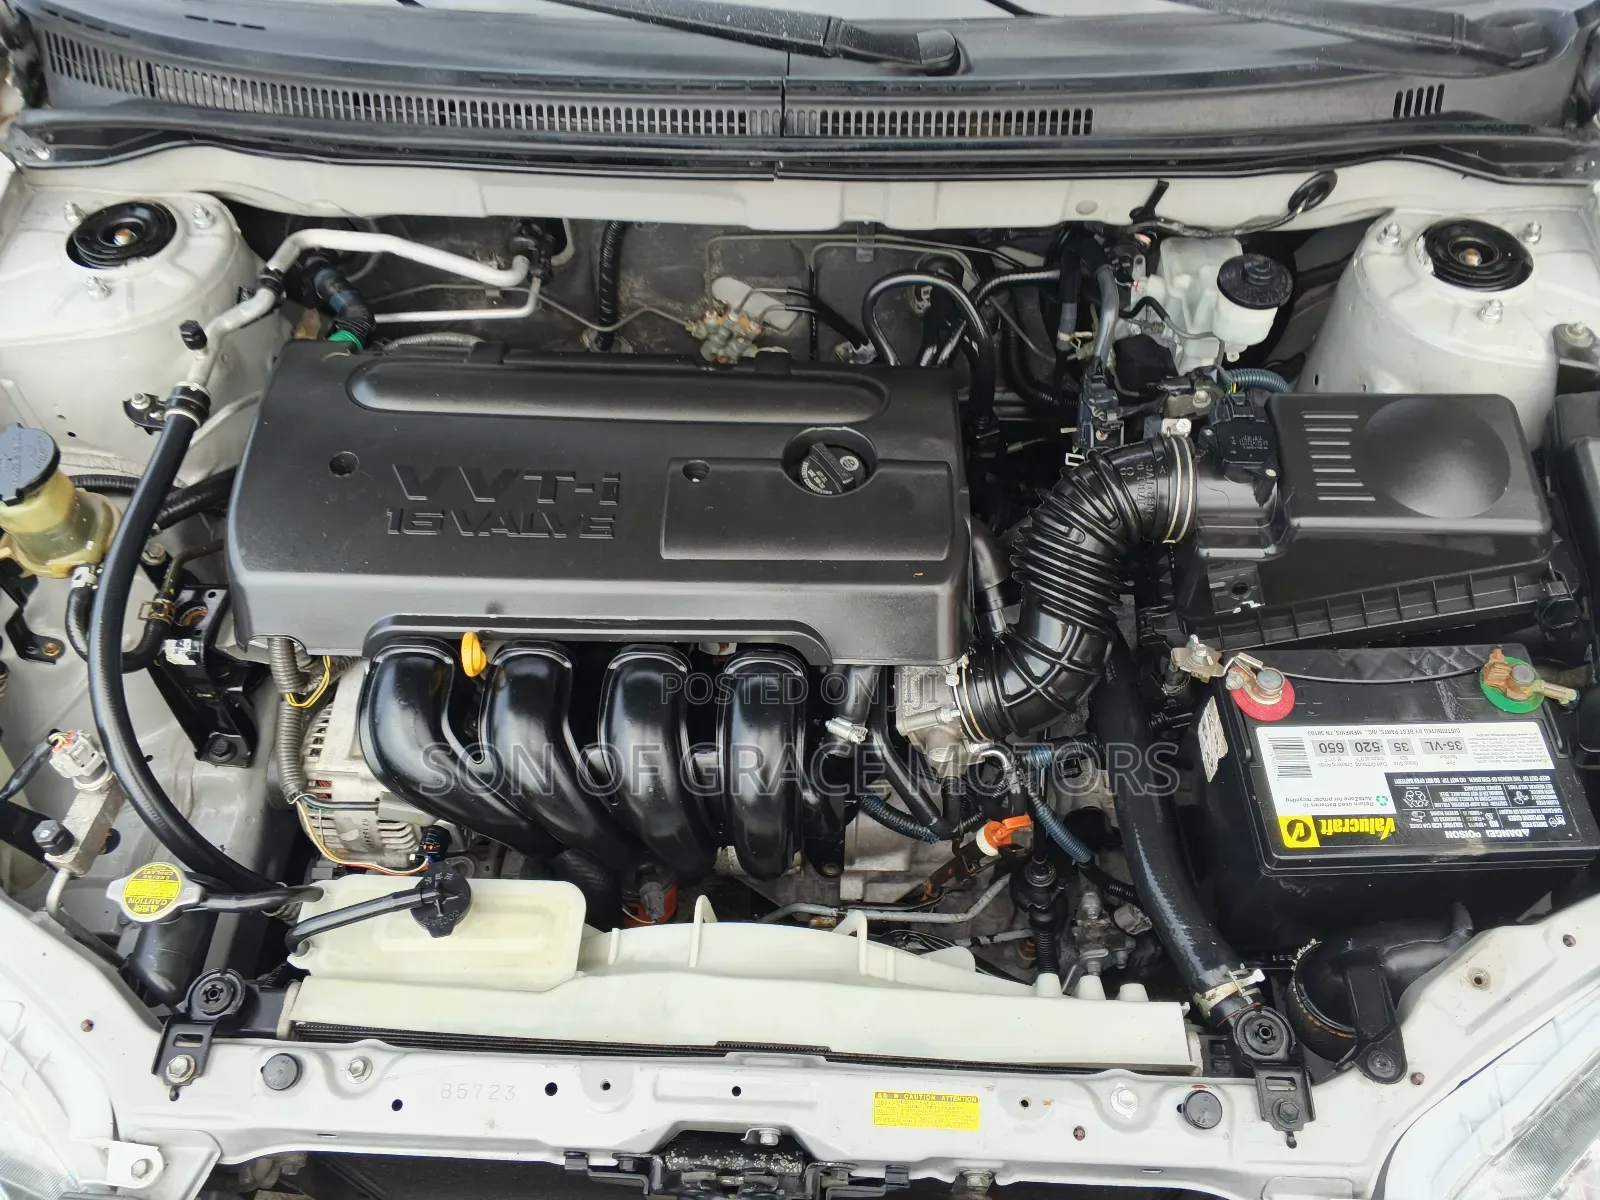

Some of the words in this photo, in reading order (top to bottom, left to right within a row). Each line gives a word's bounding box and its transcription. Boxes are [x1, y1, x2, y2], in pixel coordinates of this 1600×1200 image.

[387, 508, 444, 535] 16
[450, 510, 616, 539] VALVE
[1319, 742, 1345, 753] 650
[1394, 742, 1408, 752] 35
[1424, 740, 1463, 751] 35-VL
[1320, 817, 1396, 840] Valucraft
[128, 897, 168, 905] CAUTION
